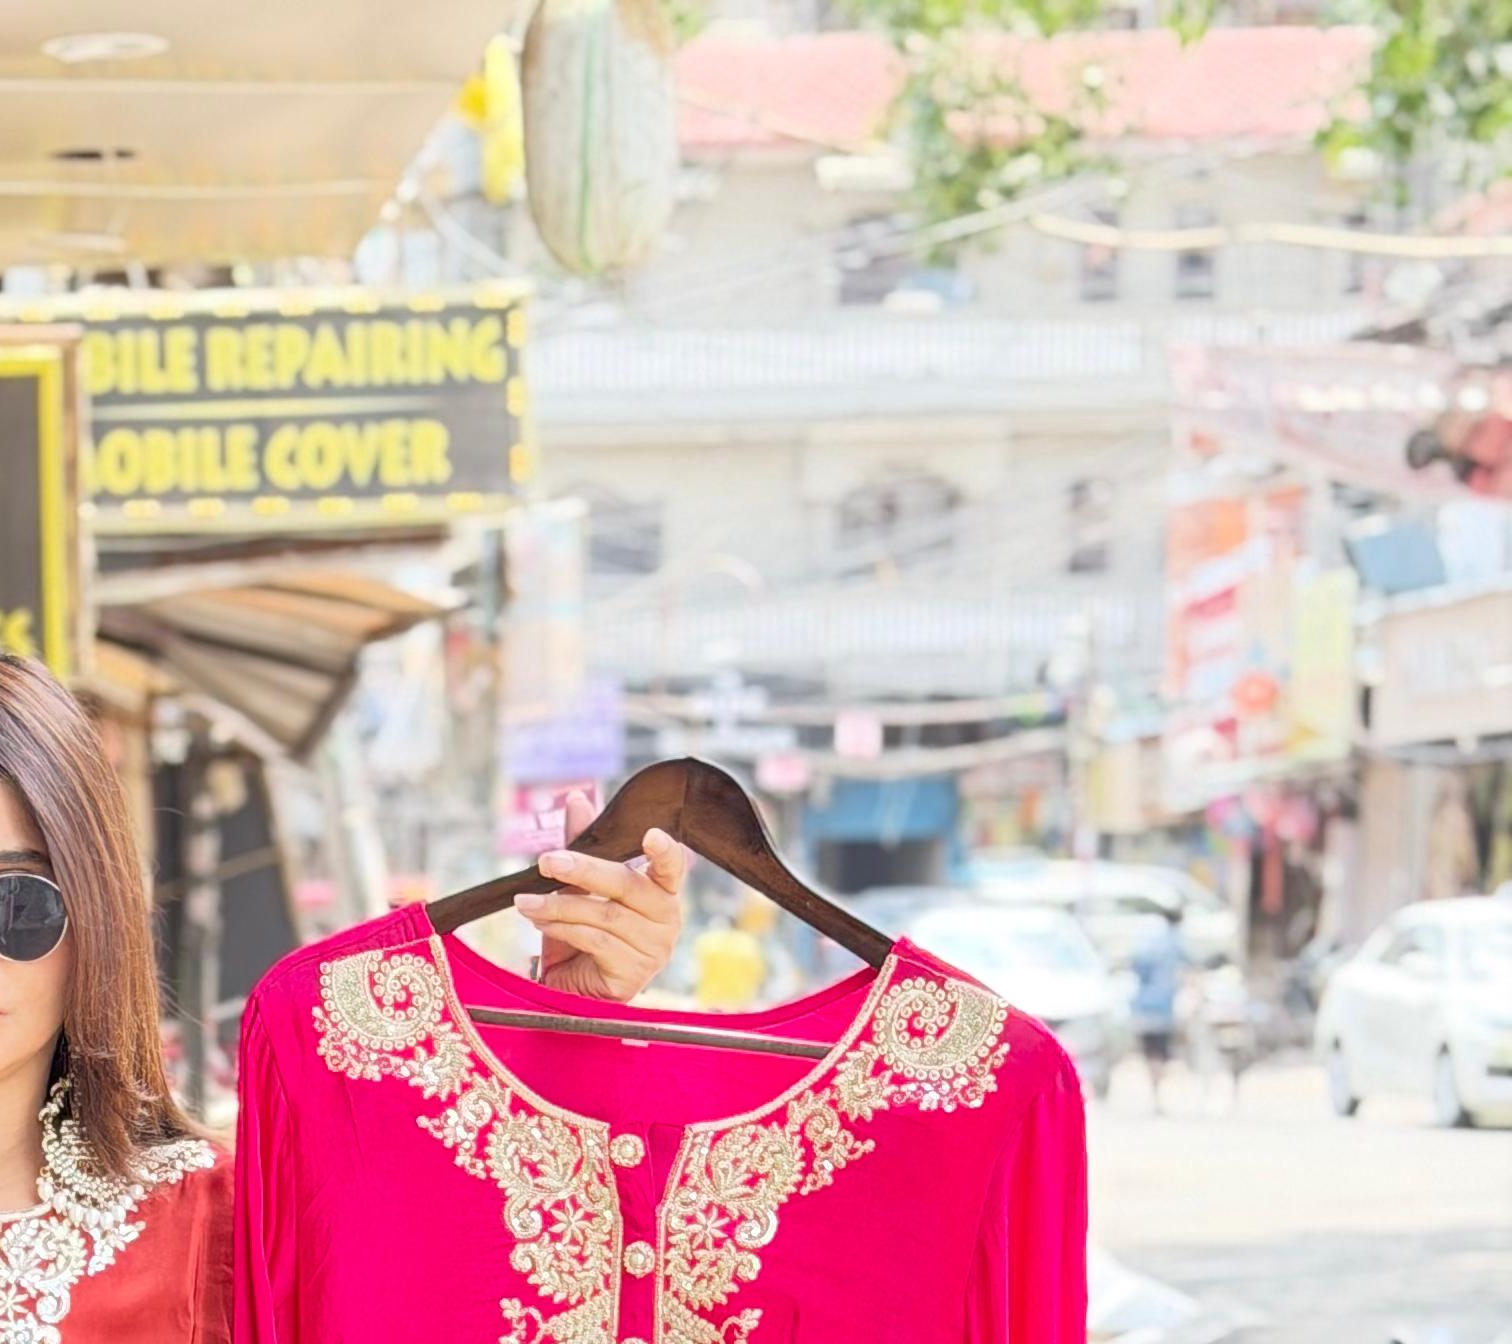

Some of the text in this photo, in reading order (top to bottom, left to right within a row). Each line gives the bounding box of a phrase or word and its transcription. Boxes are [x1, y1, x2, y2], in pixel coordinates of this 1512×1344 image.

[85, 315, 507, 395] BILE REPAIRING
[89, 418, 452, 495] OBILE COVER
